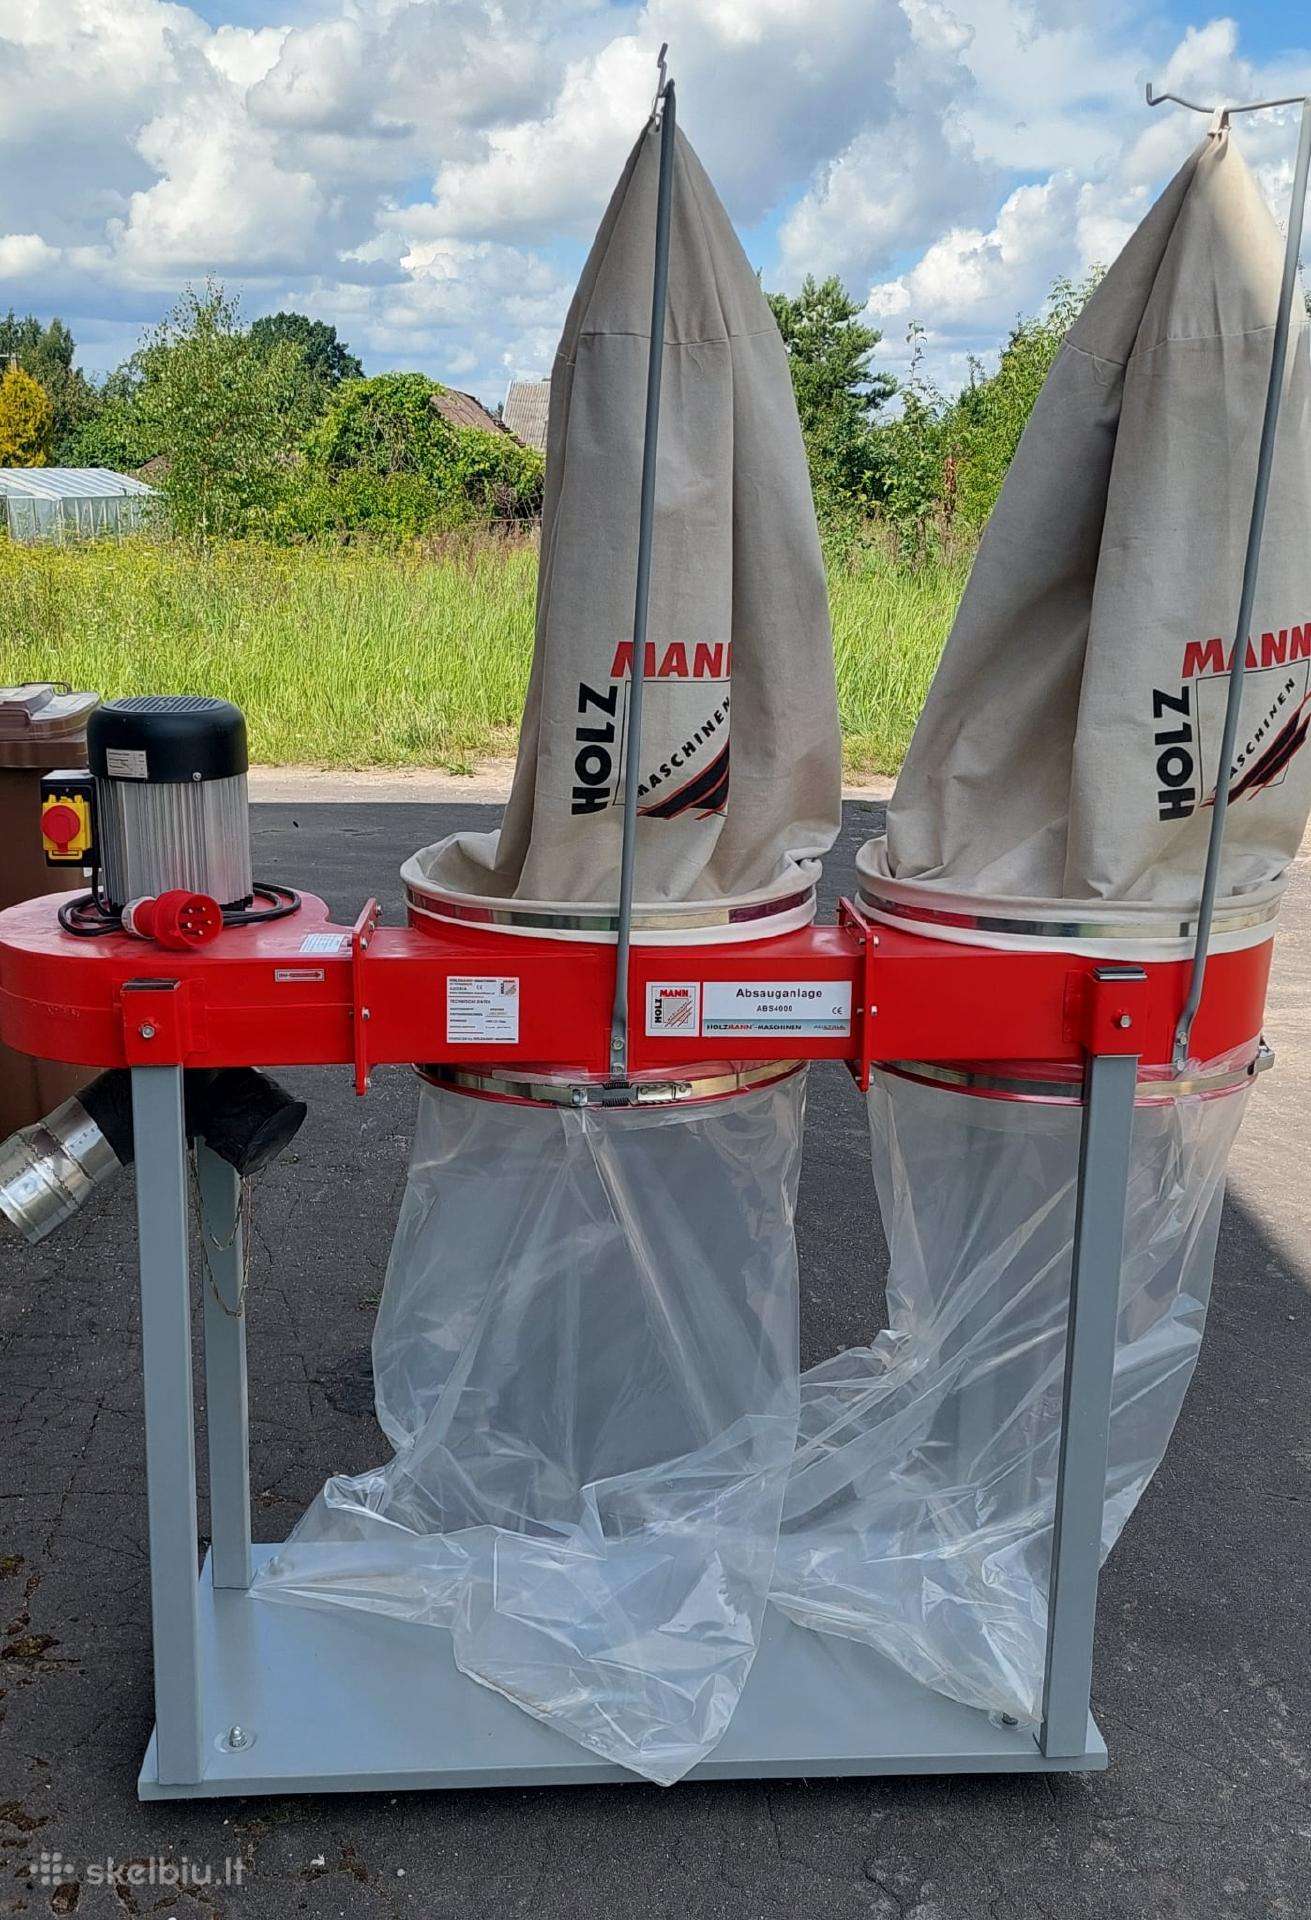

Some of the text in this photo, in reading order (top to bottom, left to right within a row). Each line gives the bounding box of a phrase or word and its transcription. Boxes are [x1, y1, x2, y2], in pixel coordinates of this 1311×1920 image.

[610, 641, 732, 678] MAN
[571, 682, 618, 815] HOLZ
[1212, 677, 1295, 792] ASCHINEN
[1153, 685, 1195, 821] HOLZ
[659, 989, 689, 998] MANN
[735, 987, 823, 1000] Absauganlage
[756, 1004, 793, 1013] ABS4000
[654, 998, 663, 1024] HOLZ
